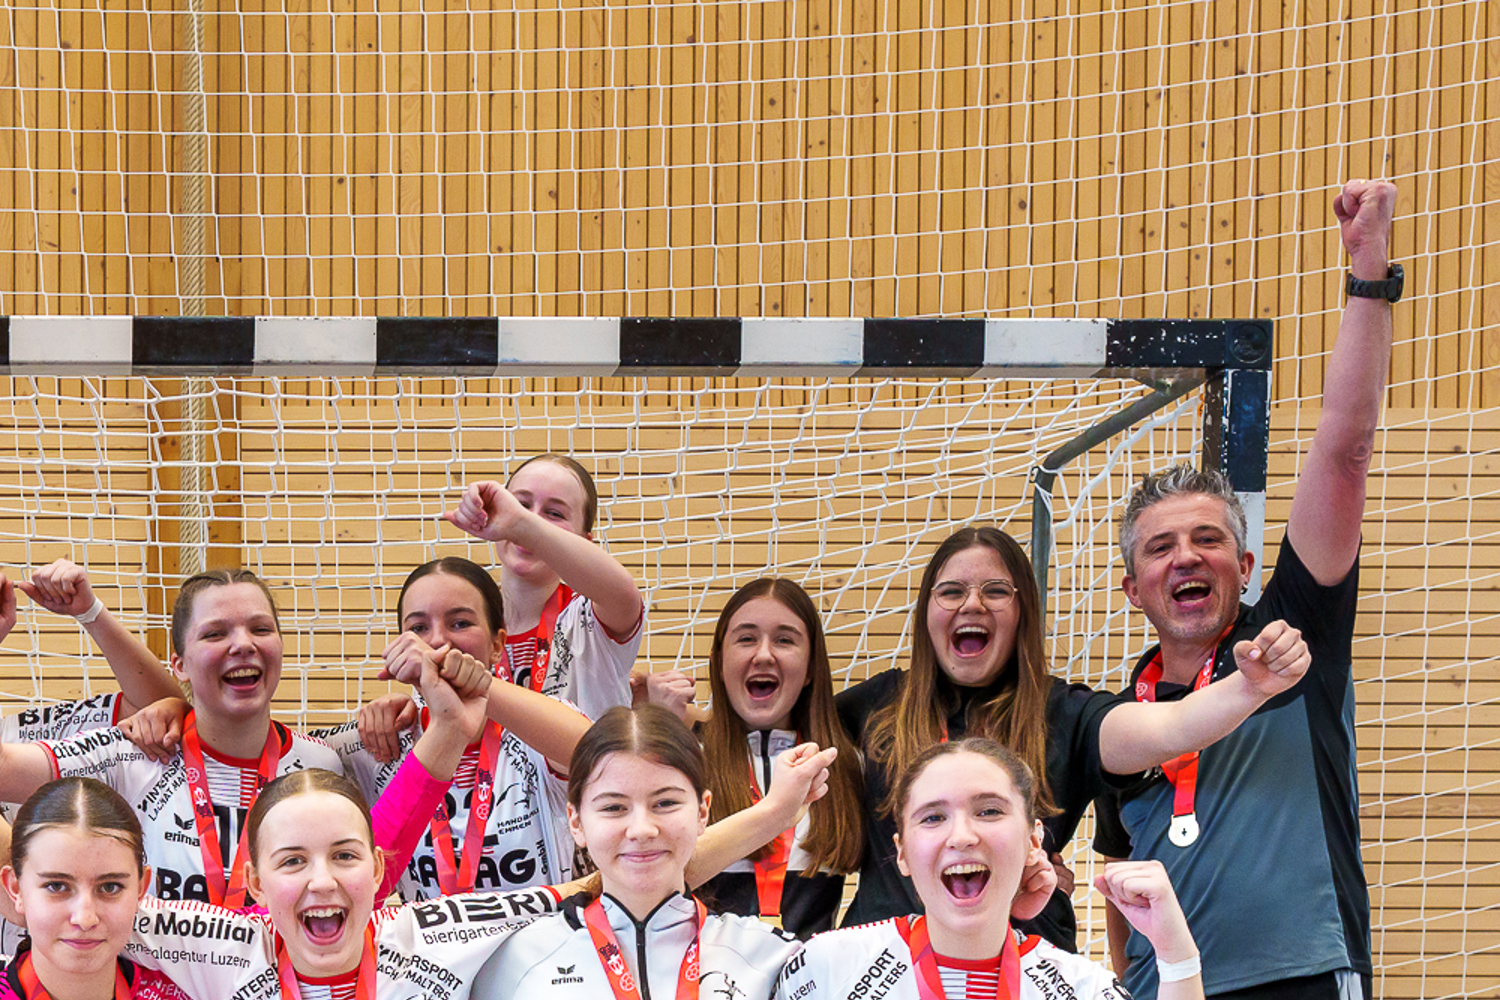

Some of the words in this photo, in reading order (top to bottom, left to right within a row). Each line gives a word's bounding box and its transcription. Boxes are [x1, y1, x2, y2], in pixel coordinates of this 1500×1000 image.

[165, 831, 200, 847] erima
[413, 891, 553, 930] BIERI
[154, 912, 256, 945] Mobiliar
[211, 951, 252, 968] Luzern
[551, 974, 584, 985] erima
